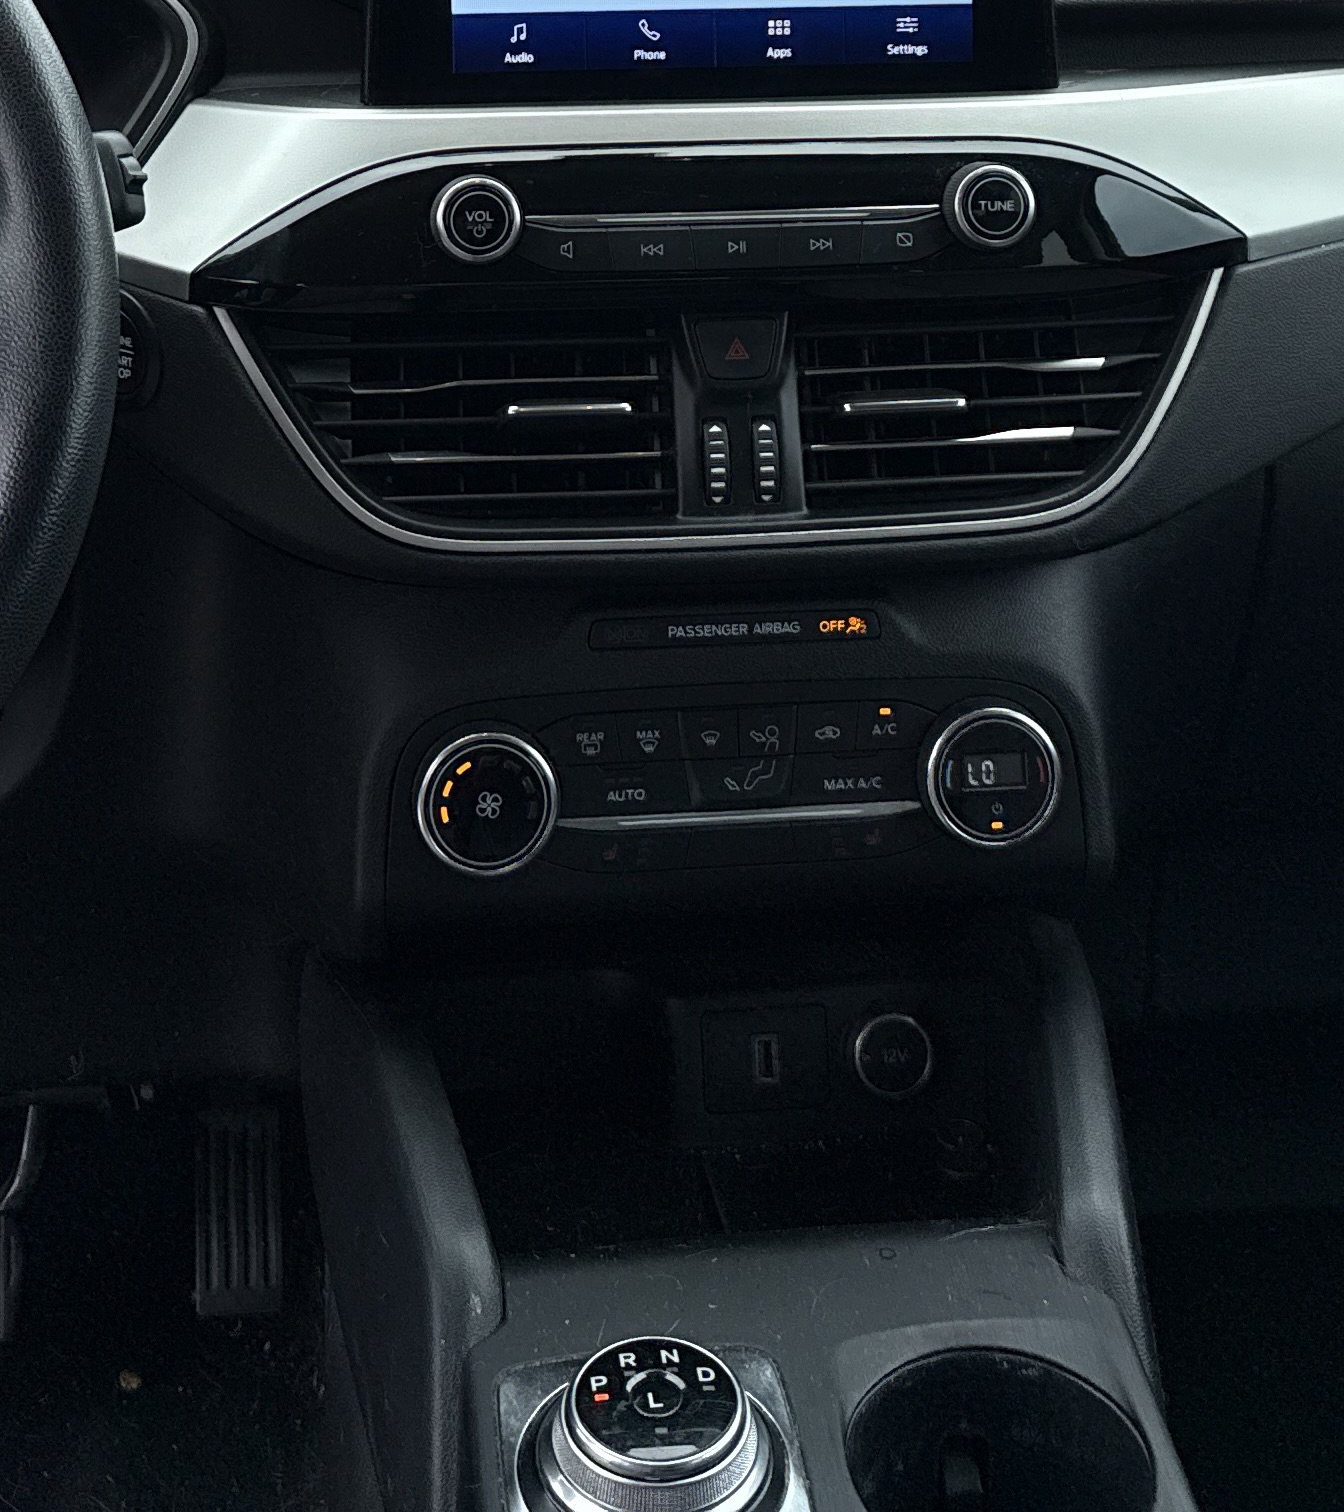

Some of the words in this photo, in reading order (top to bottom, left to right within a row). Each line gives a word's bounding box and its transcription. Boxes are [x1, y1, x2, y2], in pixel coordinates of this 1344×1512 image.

[633, 49, 666, 61] Phone
[766, 46, 792, 59] Apps
[886, 43, 928, 56] Settings
[504, 51, 534, 63] Audio
[978, 199, 1015, 211] TUNE
[465, 210, 494, 222] VOL
[667, 622, 749, 638] PASSENGER
[752, 621, 801, 636] AIRBAG
[818, 619, 845, 634] OFF
[636, 729, 661, 739] MAX
[871, 723, 897, 736] A/C
[576, 731, 605, 742] REAR
[823, 778, 855, 790] MAX
[857, 776, 883, 789] A/C
[607, 788, 646, 801] AUTO
[589, 1375, 608, 1392] P
[618, 1352, 637, 1368] R
[659, 1348, 680, 1364] N
[696, 1366, 716, 1382] D
[647, 1391, 664, 1409] L
